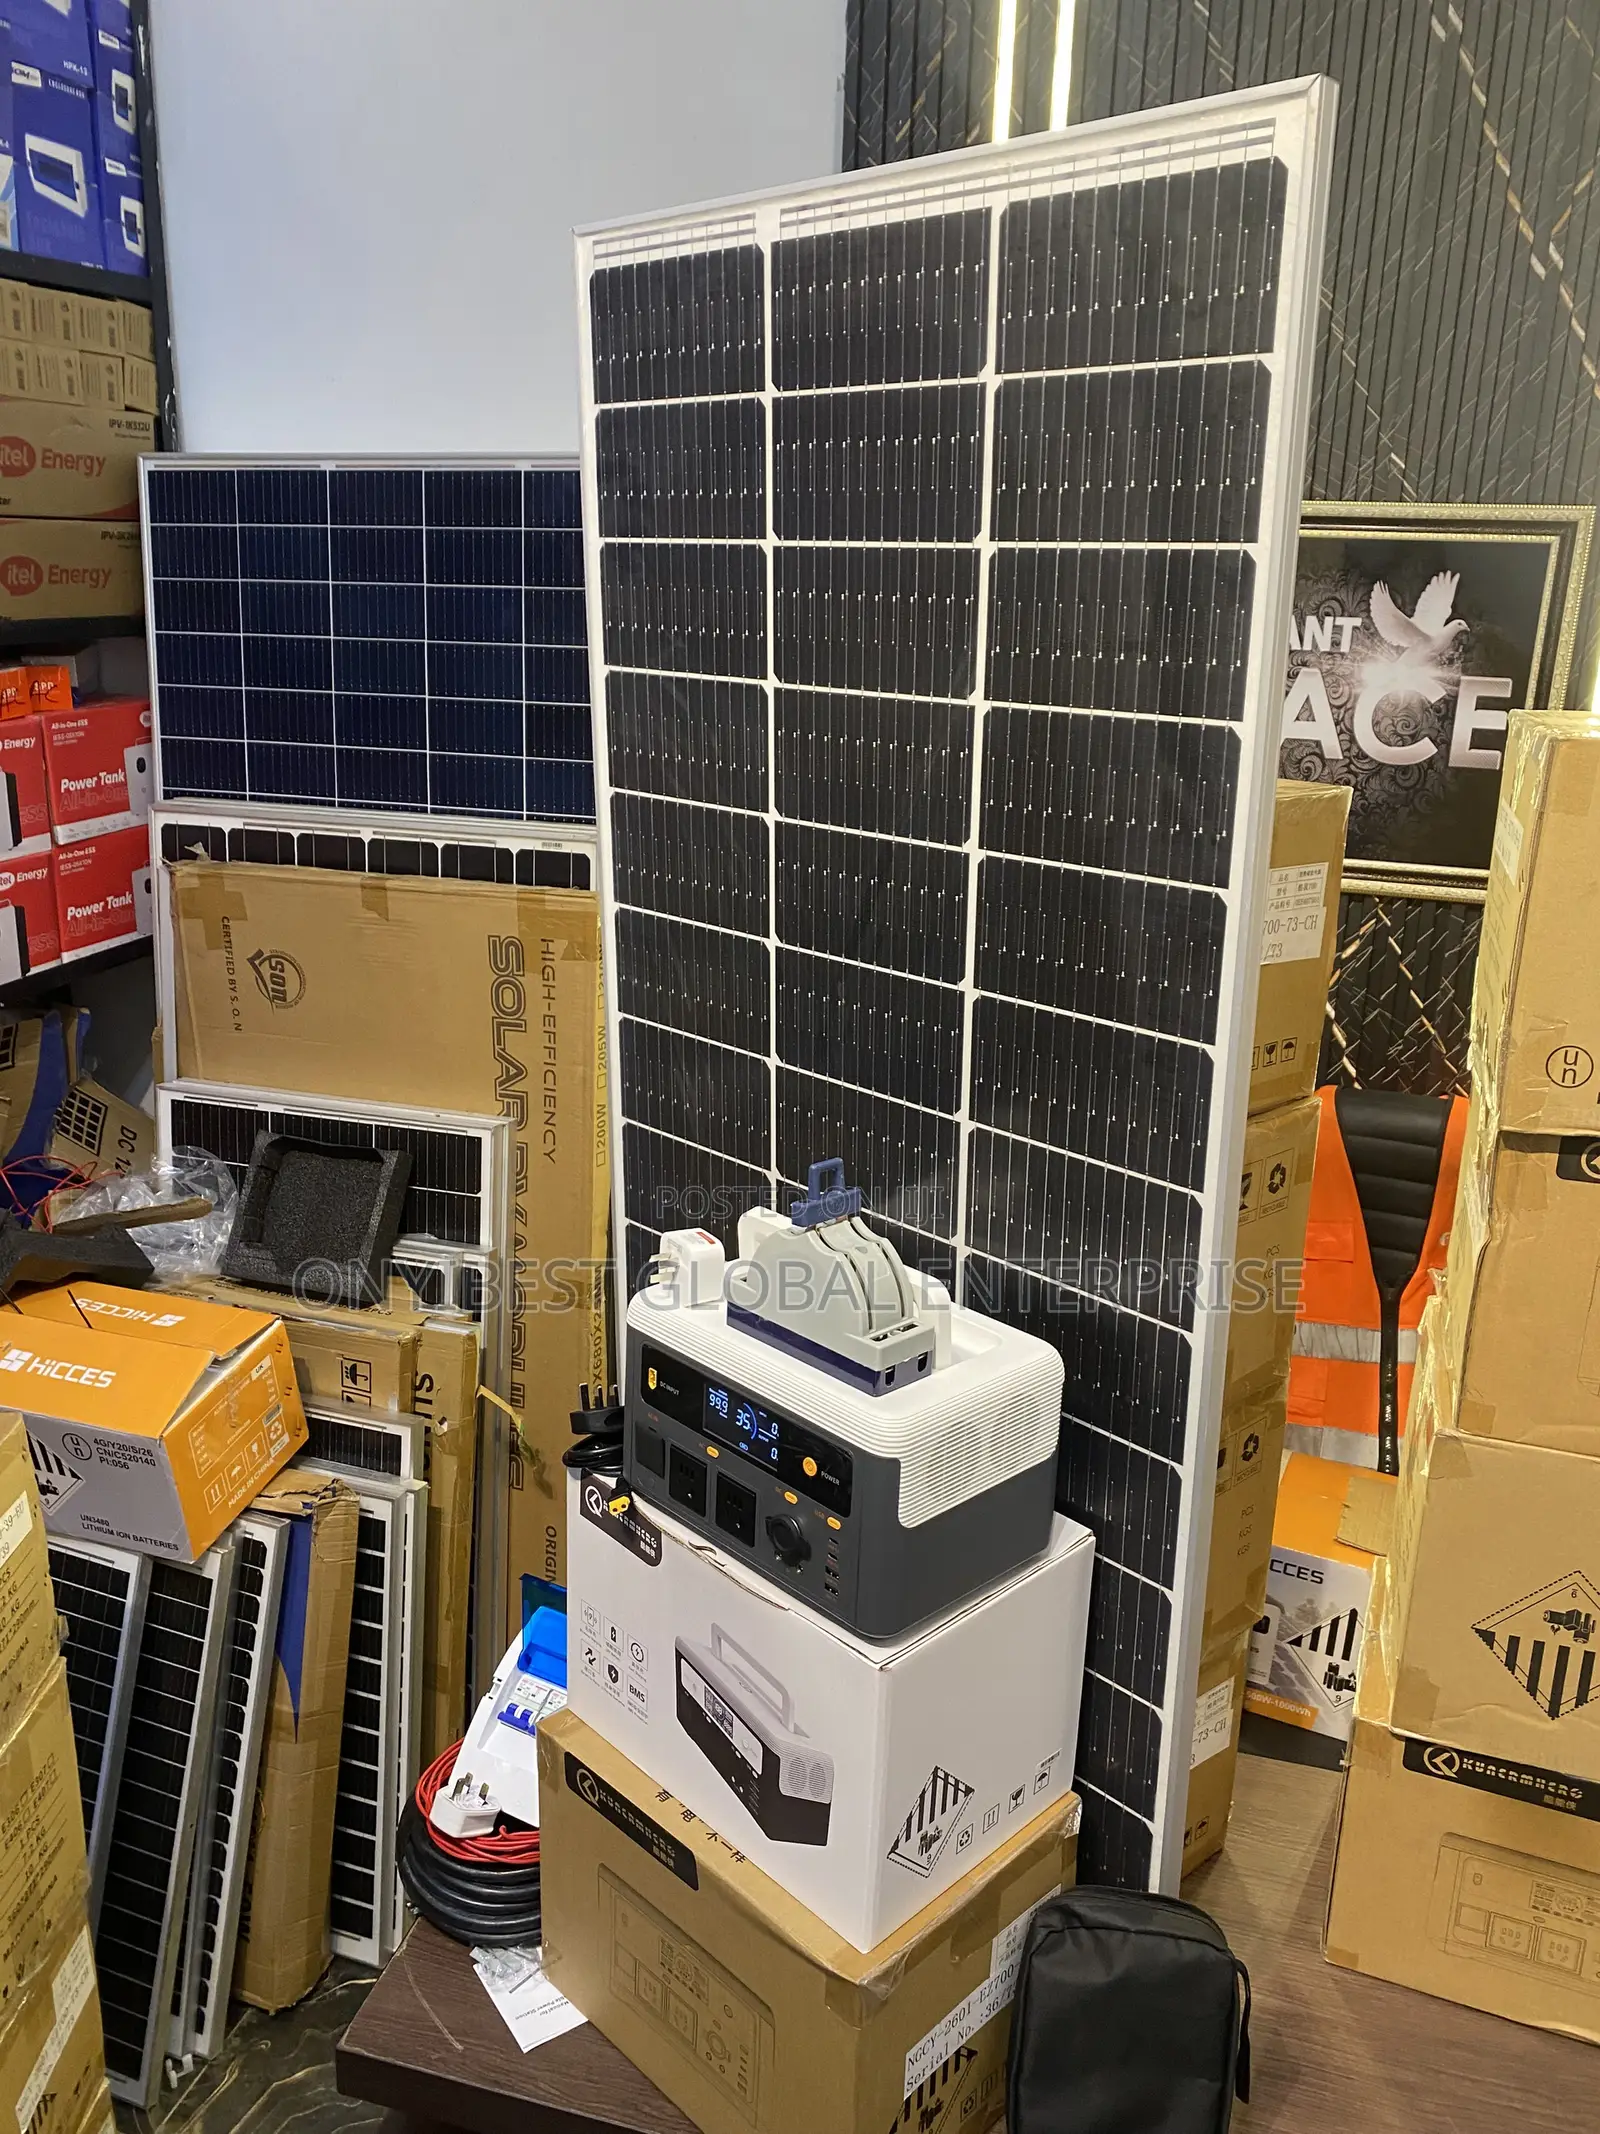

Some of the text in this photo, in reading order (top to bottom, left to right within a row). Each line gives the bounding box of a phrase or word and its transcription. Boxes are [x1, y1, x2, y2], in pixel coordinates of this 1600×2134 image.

[41, 448, 106, 476] Energy
[7, 564, 111, 588] itel Energy
[4, 737, 36, 750] Energy
[61, 768, 125, 793] Power Tank
[17, 867, 48, 883] Energy
[67, 891, 133, 920] Power Tank
[221, 916, 236, 976] CERTIFIED
[227, 979, 238, 993] BY
[540, 938, 557, 1165] HIGH-EFFICIENCY
[597, 1023, 607, 1071] 205W
[118, 1125, 137, 1153] DC
[596, 1103, 607, 1148] 200W
[228, 1487, 246, 1508] MADE
[254, 1457, 275, 1479] CHINA
[820, 1470, 841, 1486] POWER
[80, 1514, 110, 1527] UN3480
[82, 1522, 179, 1551] LITHIUM ION BATTERIES
[629, 1684, 645, 1703] BMS
[906, 2040, 950, 2093] Serial
[956, 2023, 975, 2044] No.
